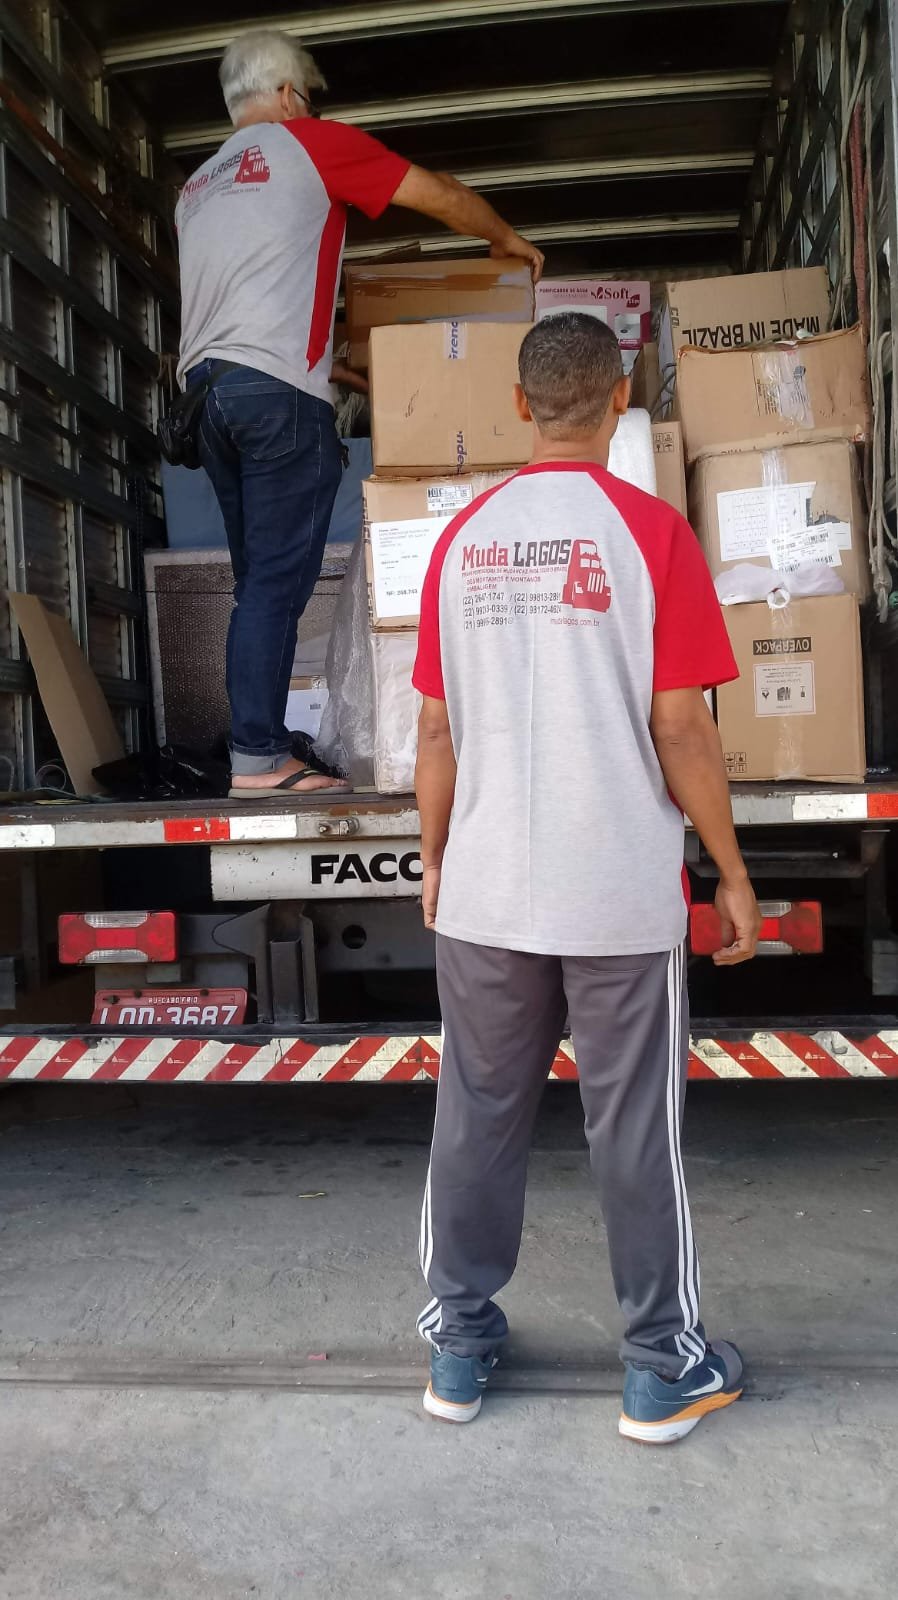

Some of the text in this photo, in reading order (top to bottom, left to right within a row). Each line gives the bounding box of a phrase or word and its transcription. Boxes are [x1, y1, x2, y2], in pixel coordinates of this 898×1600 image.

[183, 150, 245, 199] Muda LAGOS
[604, 287, 631, 300] Soft
[682, 316, 820, 349] MADE IN BRAZIL
[462, 539, 571, 570] Muda LAGOS
[514, 592, 527, 603] (22)
[514, 605, 527, 616] (22)
[755, 638, 810, 654] OVERPACK
